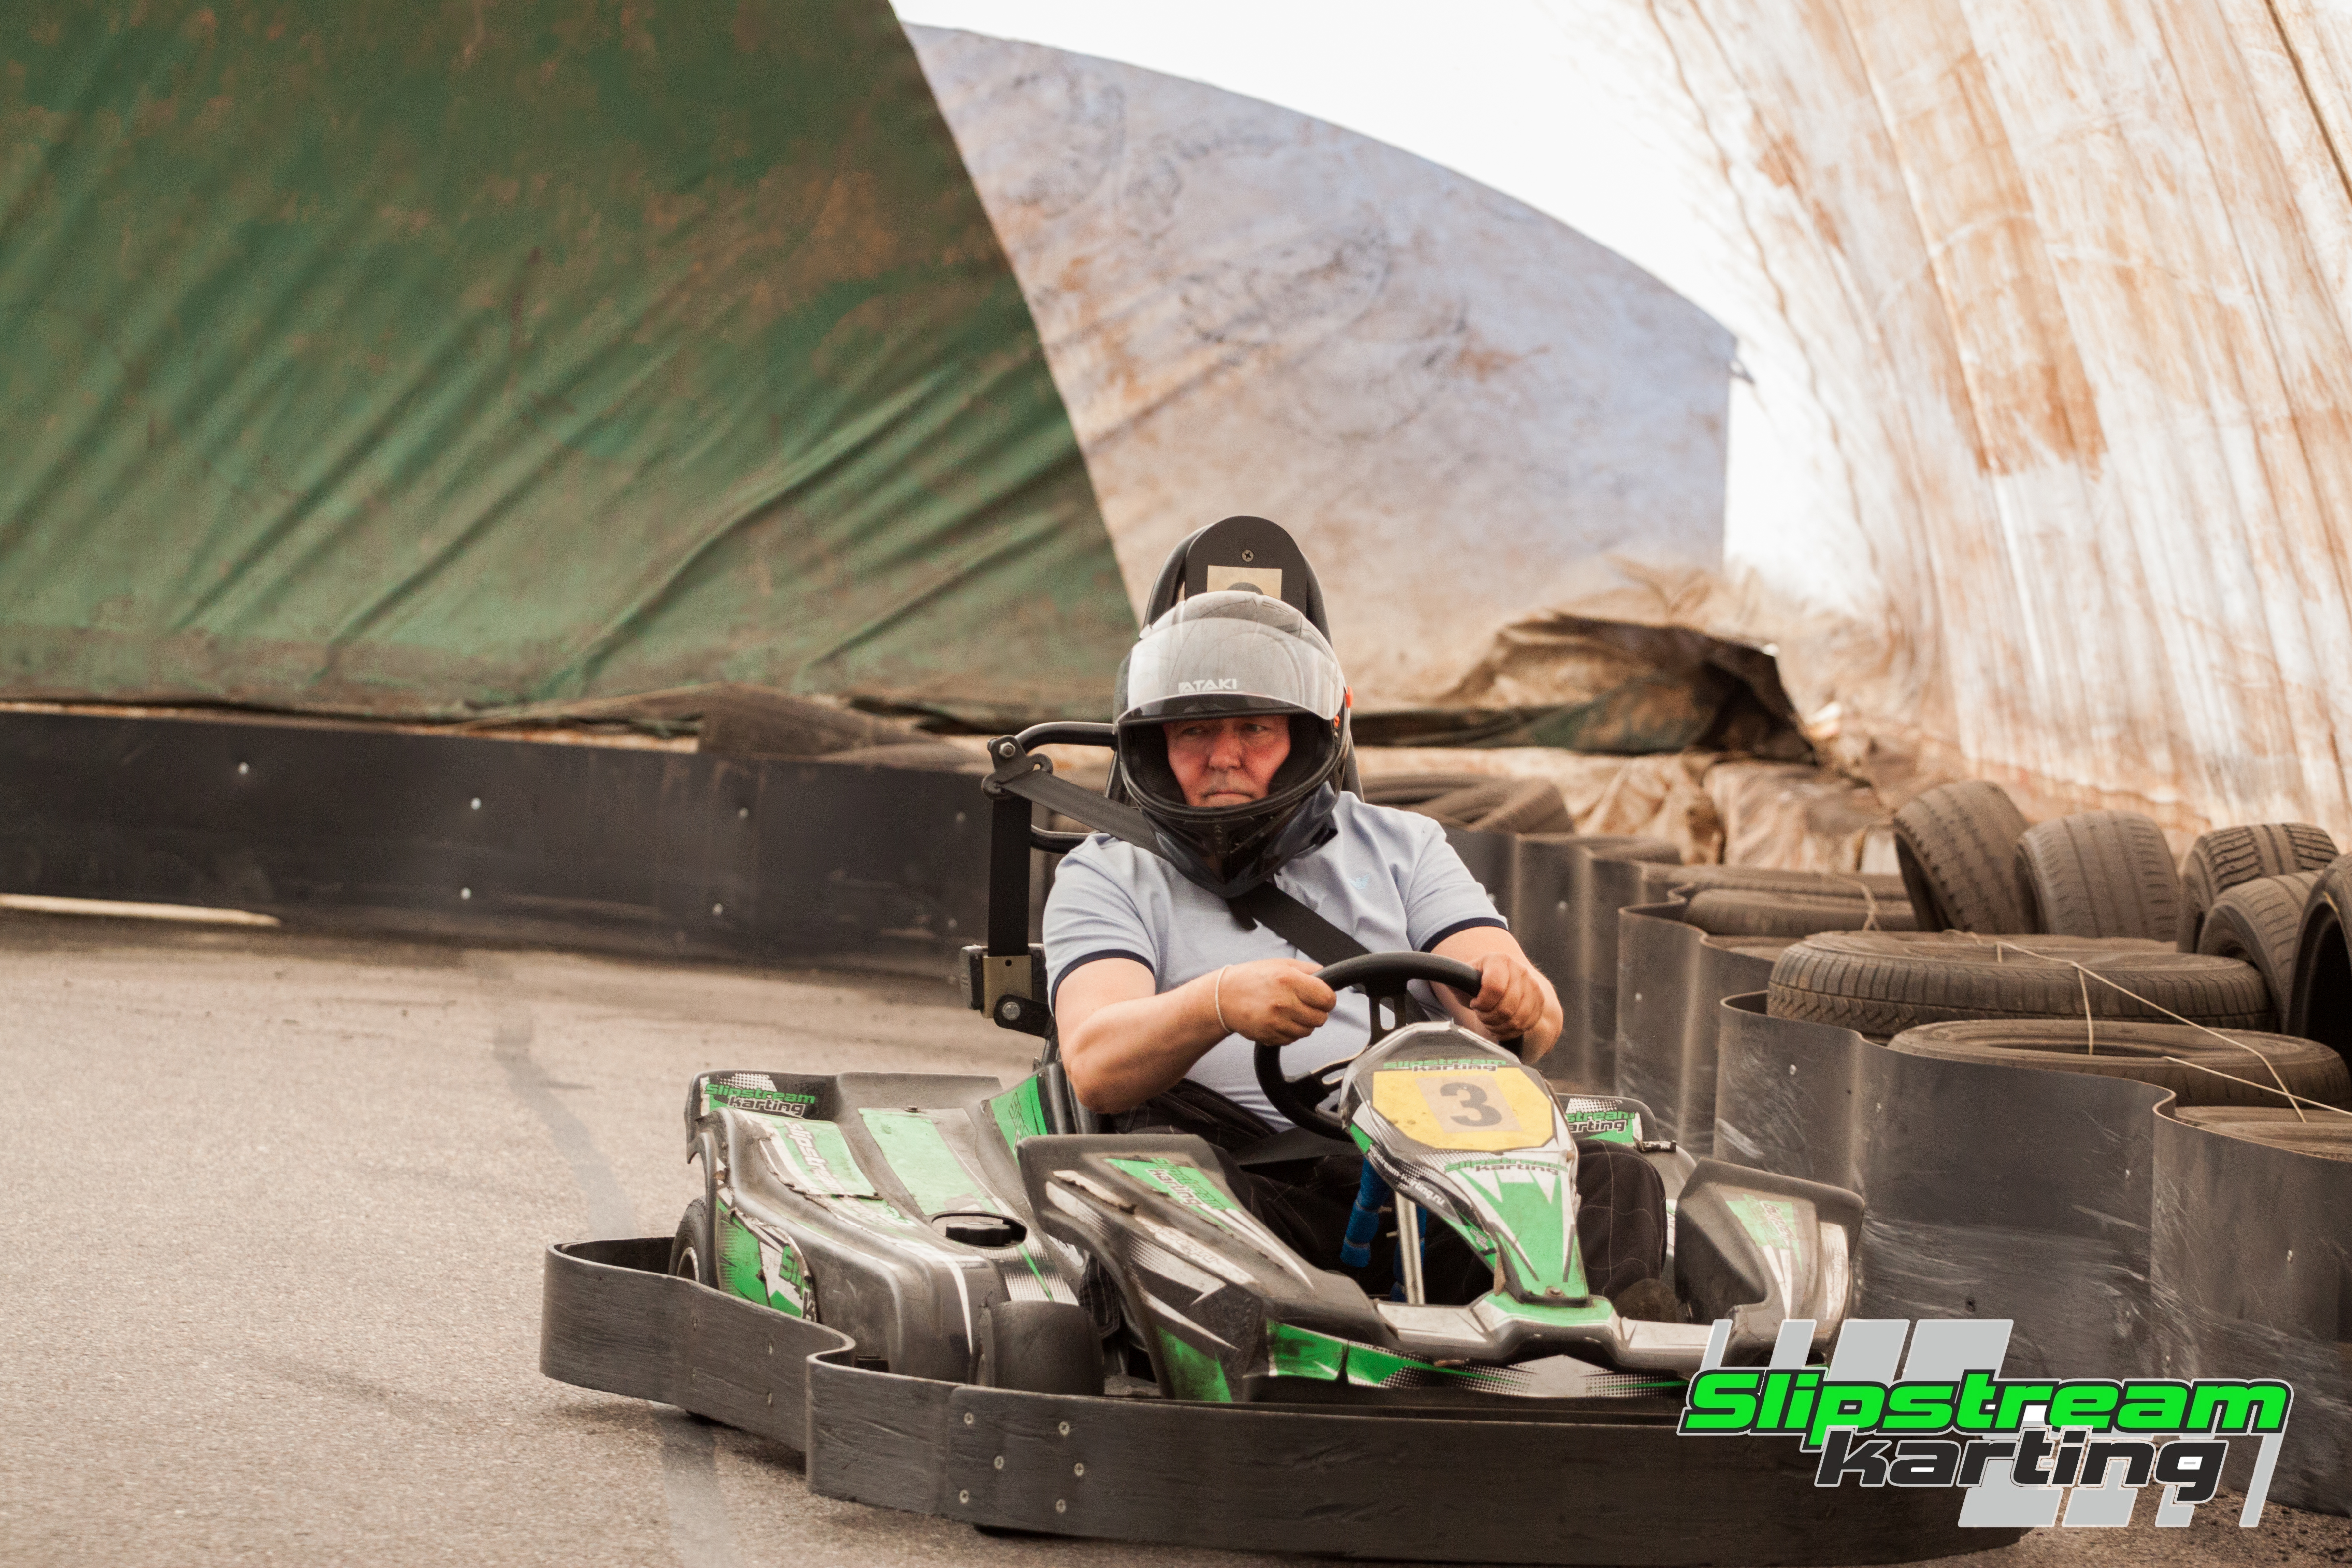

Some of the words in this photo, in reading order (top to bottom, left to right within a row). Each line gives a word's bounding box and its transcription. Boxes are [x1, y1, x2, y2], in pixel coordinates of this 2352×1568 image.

[1178, 678, 1237, 694] ATAKI
[705, 1083, 816, 1104] Slipstream
[727, 1095, 806, 1117] karting
[1440, 1082, 1502, 1127] 3
[1568, 1120, 1627, 1133] arting
